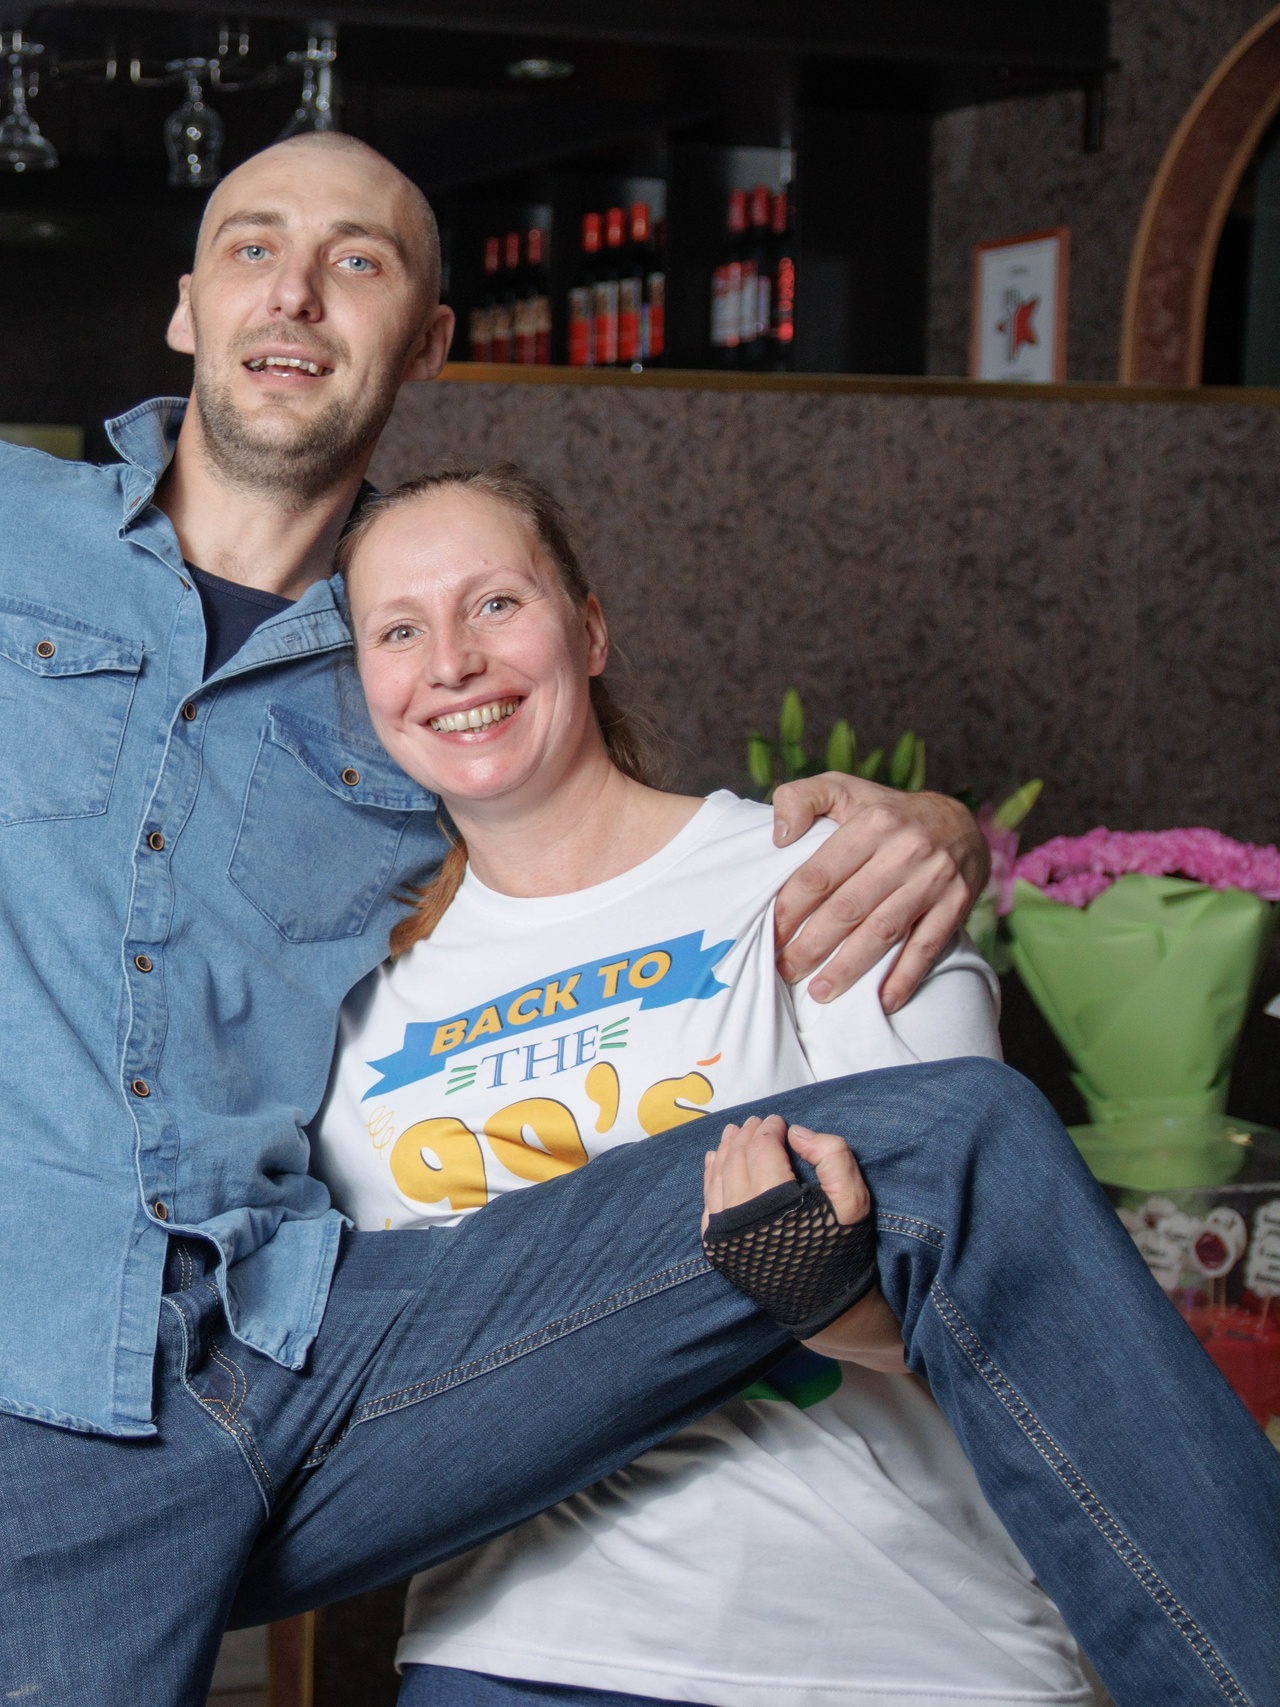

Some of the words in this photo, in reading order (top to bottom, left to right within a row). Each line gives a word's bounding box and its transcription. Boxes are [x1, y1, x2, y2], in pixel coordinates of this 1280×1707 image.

[430, 974, 582, 1056] BACK
[598, 950, 673, 999] TO
[481, 1025, 601, 1089] THE
